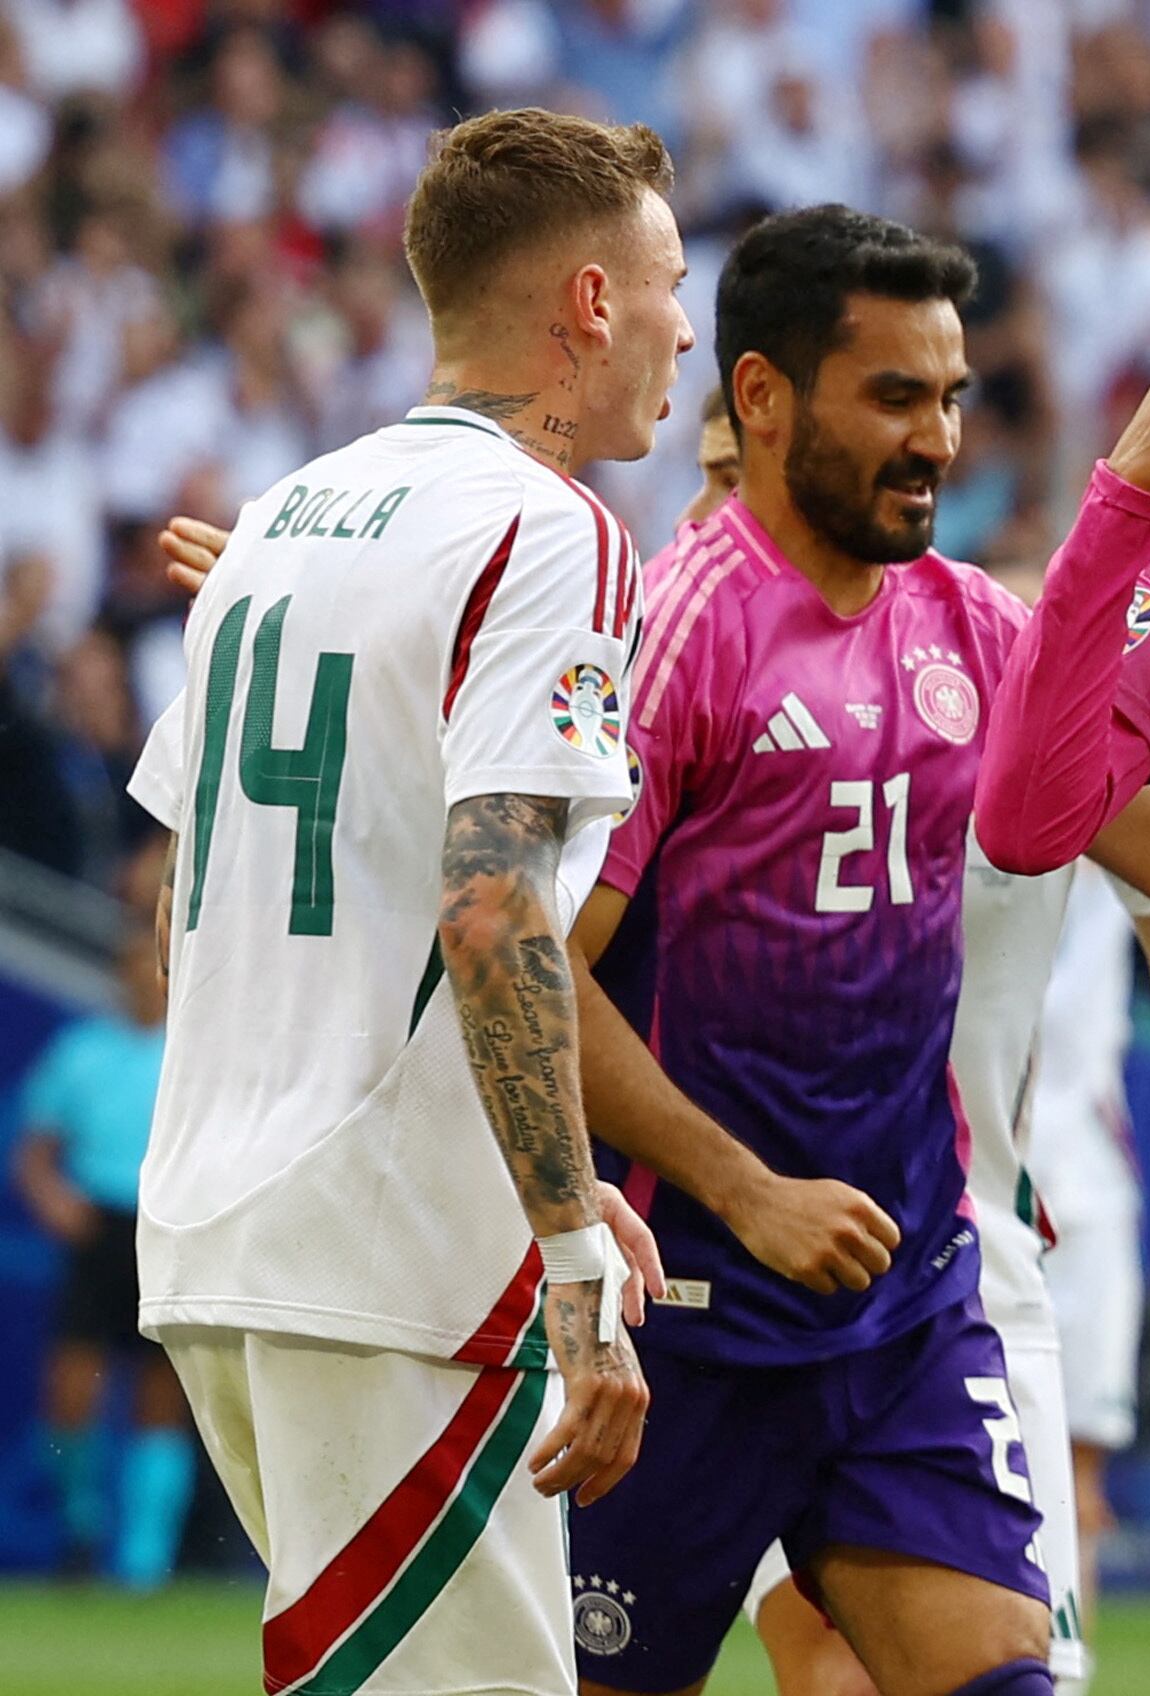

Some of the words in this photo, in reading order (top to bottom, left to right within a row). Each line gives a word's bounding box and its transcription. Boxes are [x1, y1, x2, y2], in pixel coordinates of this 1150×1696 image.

[266, 486, 411, 539] BOLLA
[186, 594, 355, 936] 14
[815, 773, 914, 912] 21
